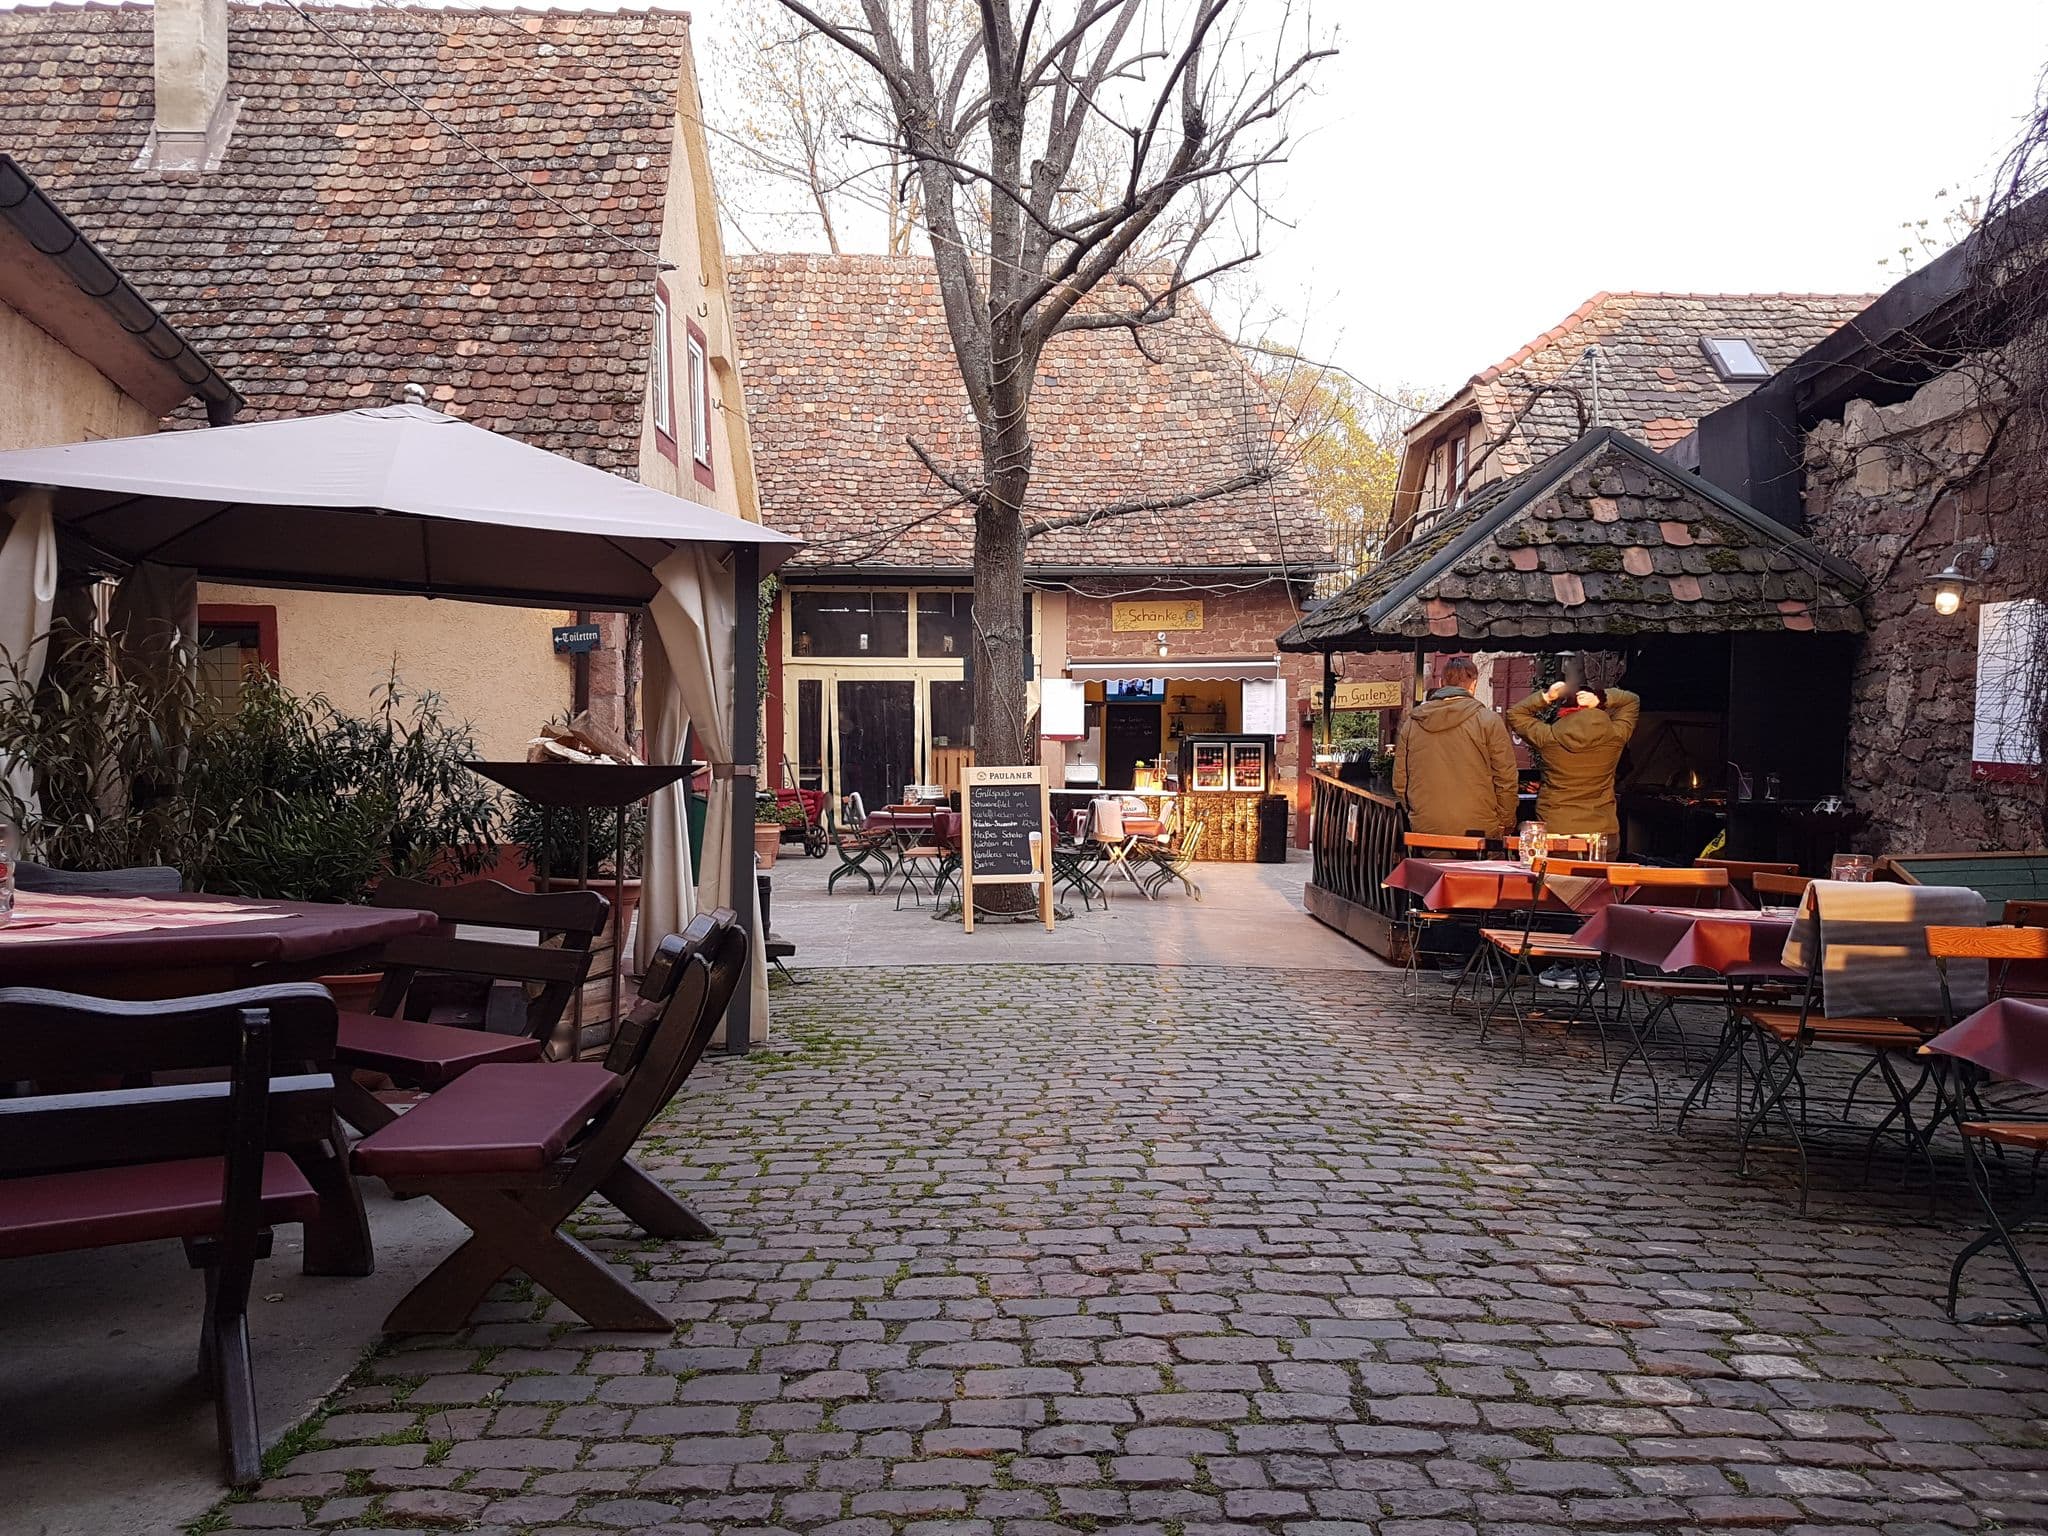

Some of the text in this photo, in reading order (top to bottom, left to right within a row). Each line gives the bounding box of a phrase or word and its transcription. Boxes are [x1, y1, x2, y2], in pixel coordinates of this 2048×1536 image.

[1128, 607, 1178, 622] Schänke
[562, 632, 598, 643] Toiletten
[989, 771, 1033, 780] PAULANER
